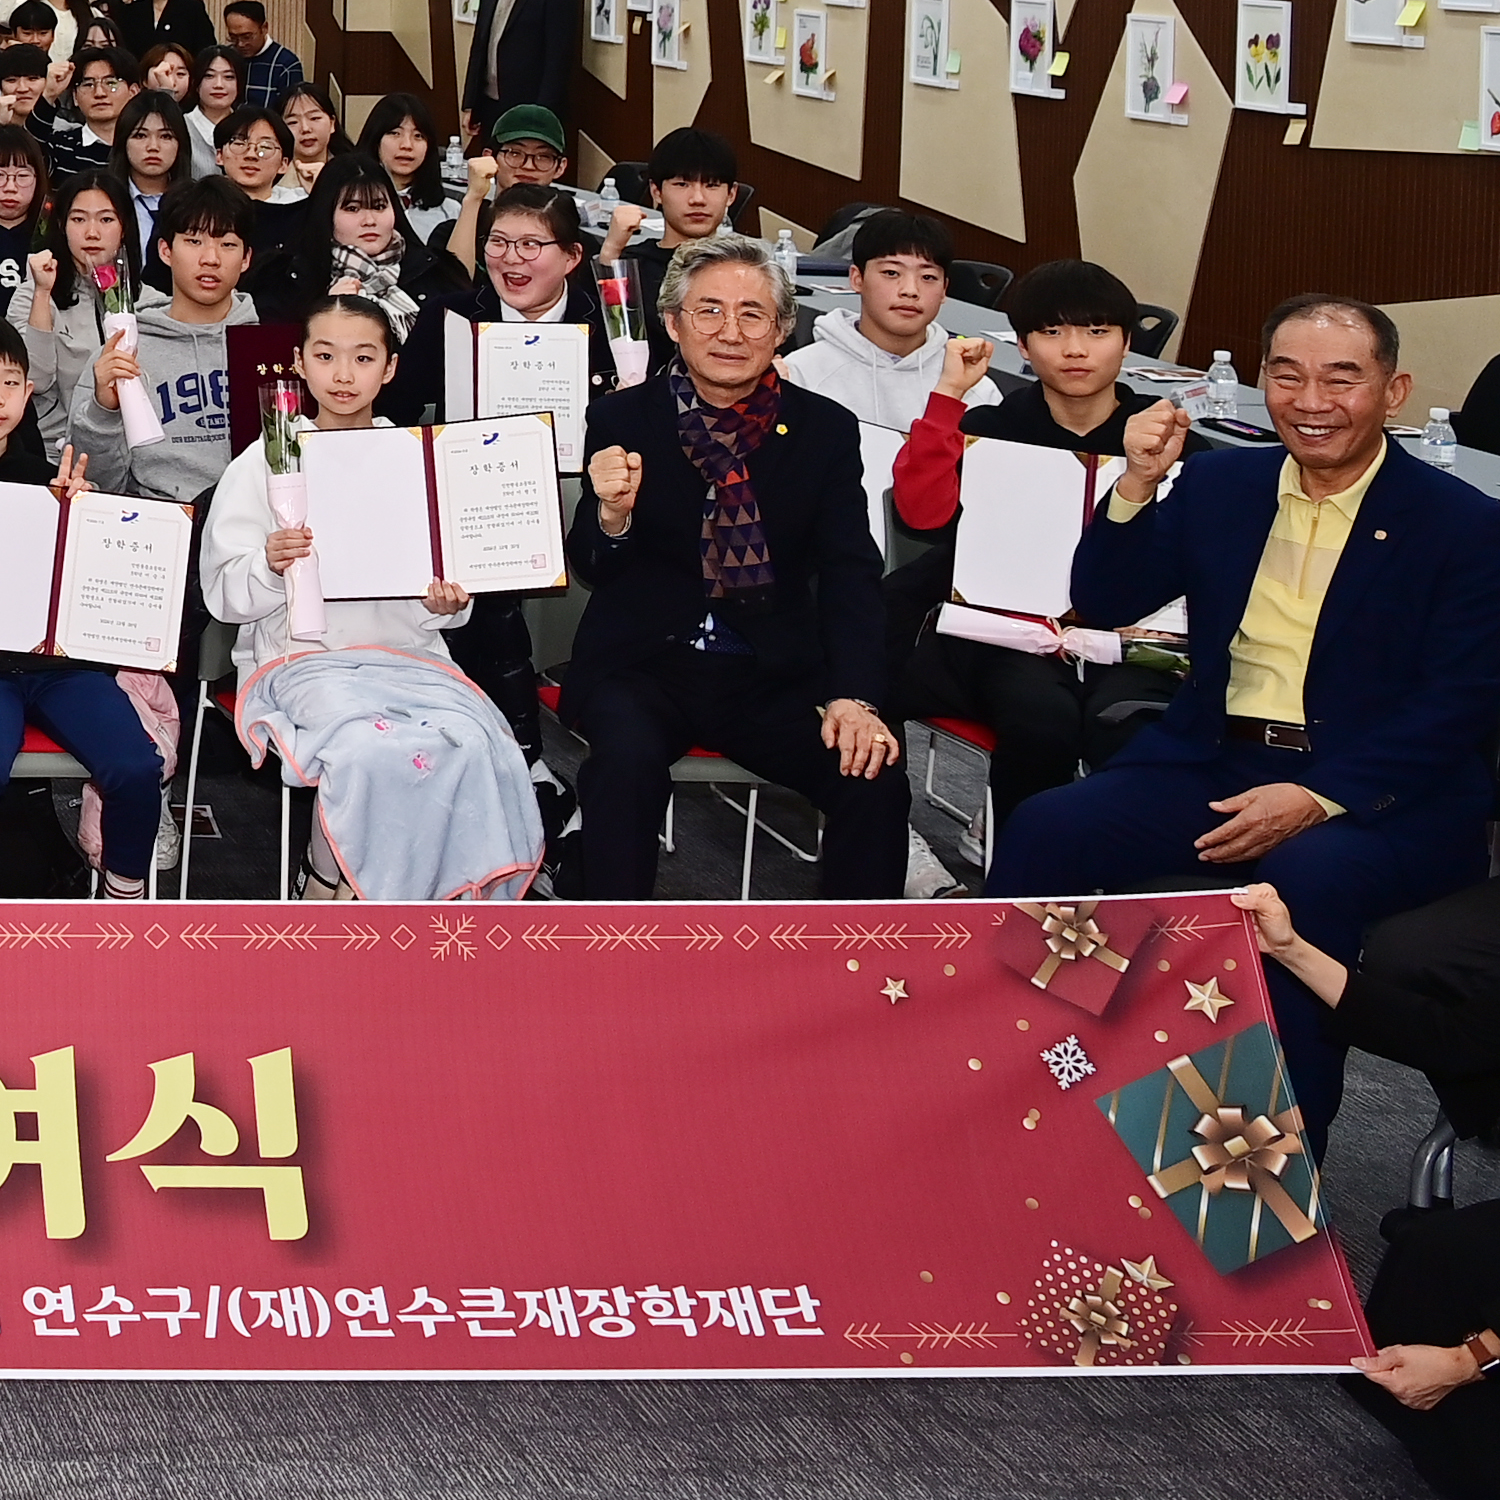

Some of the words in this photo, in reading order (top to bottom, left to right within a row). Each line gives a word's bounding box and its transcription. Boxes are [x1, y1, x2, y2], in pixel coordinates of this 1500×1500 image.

[469, 460, 520, 476] 장학증서
[102, 537, 153, 554] 장학증서
[21, 1283, 826, 1340] 연수구/(재)연수큰재장학재단
